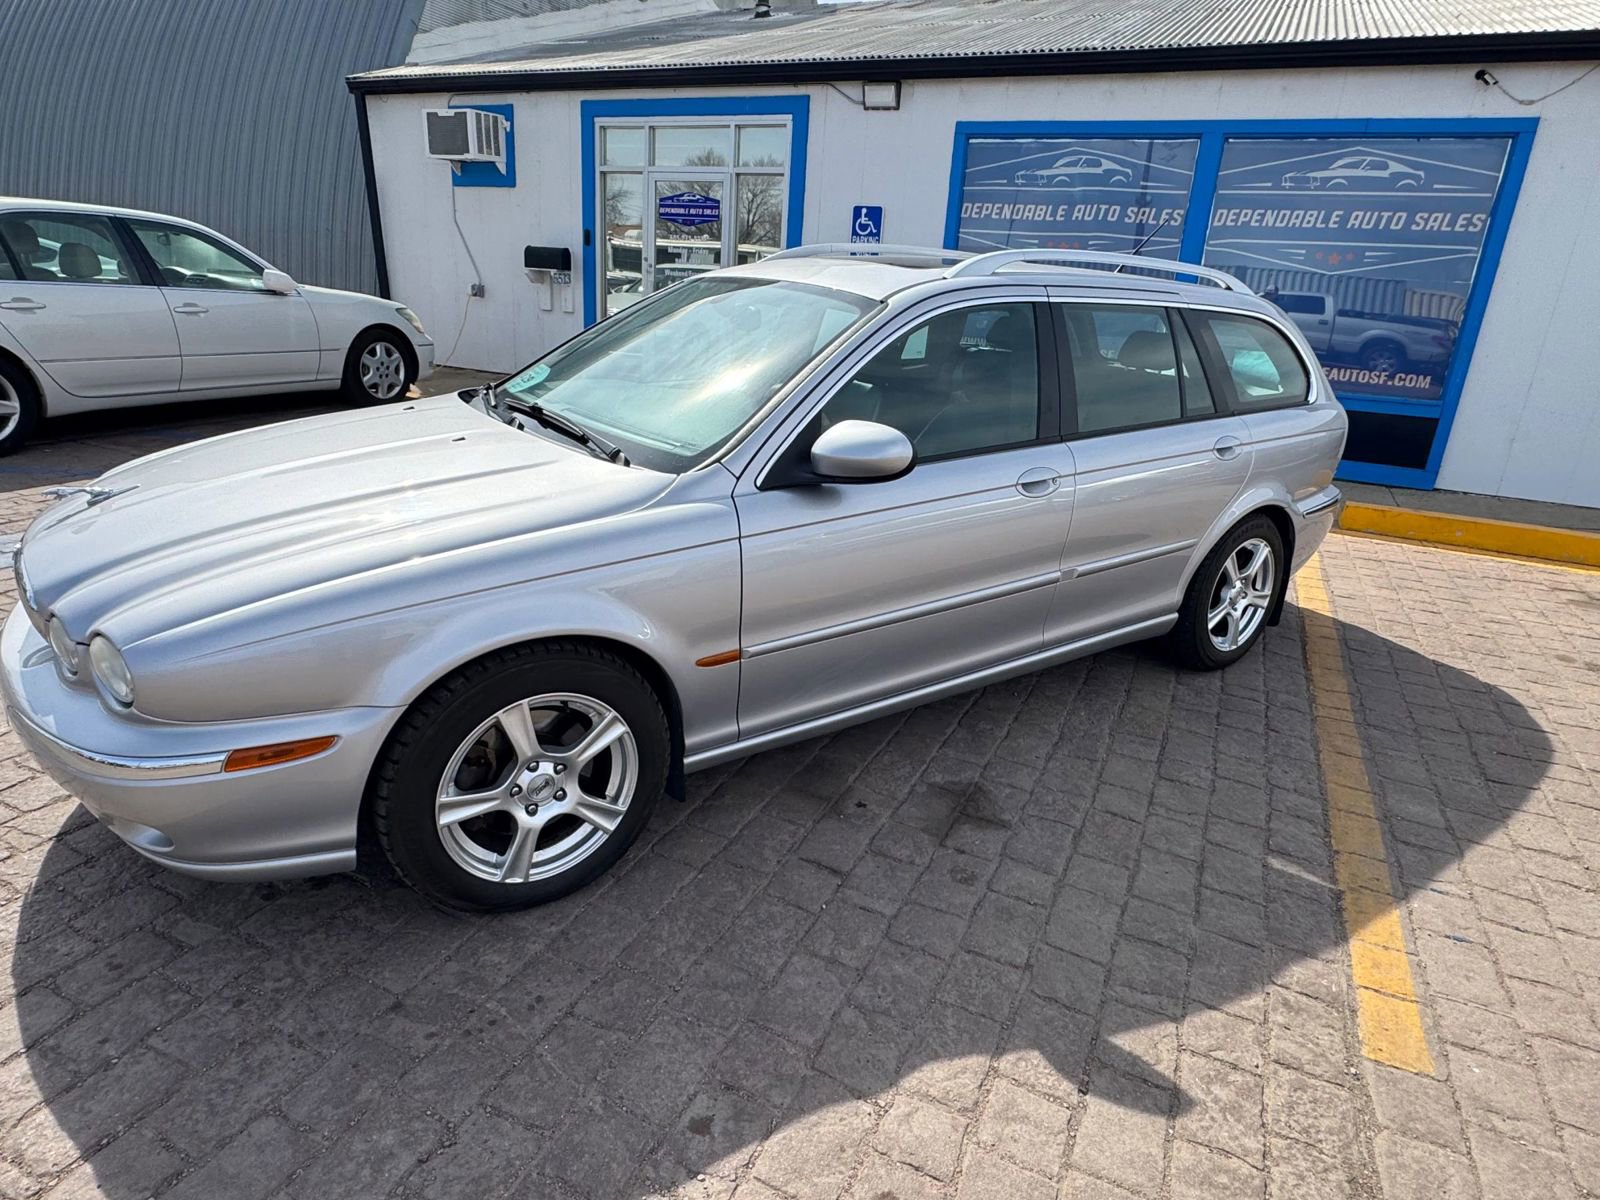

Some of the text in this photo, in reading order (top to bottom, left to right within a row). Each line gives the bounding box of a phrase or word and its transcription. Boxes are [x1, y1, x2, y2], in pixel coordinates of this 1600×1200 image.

[960, 202, 1185, 226] DEPENDABLE AUTO SALES
[1212, 208, 1488, 233] DEPENDABLE AUTO SALES
